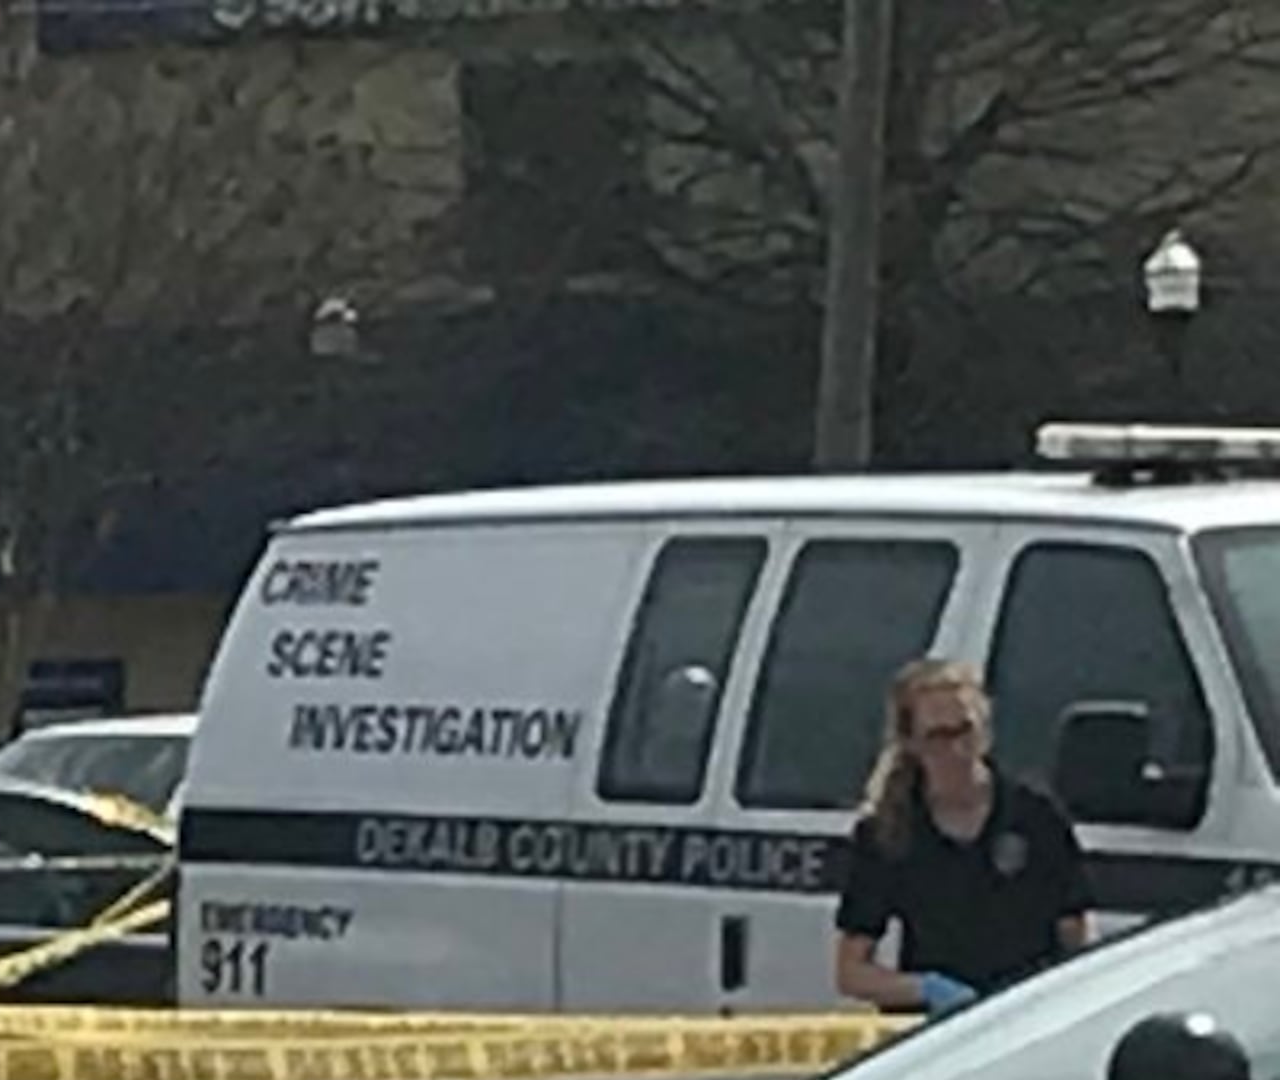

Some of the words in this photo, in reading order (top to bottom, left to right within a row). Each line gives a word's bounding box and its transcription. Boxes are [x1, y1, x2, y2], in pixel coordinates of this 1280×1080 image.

[261, 560, 380, 606] CRIME
[266, 630, 391, 678] SCENE
[290, 703, 582, 759] INVESTIGATION
[356, 816, 500, 868] DEKALB
[510, 823, 676, 877] COUNTY
[680, 834, 828, 886] POLICE
[201, 938, 269, 997] 911
